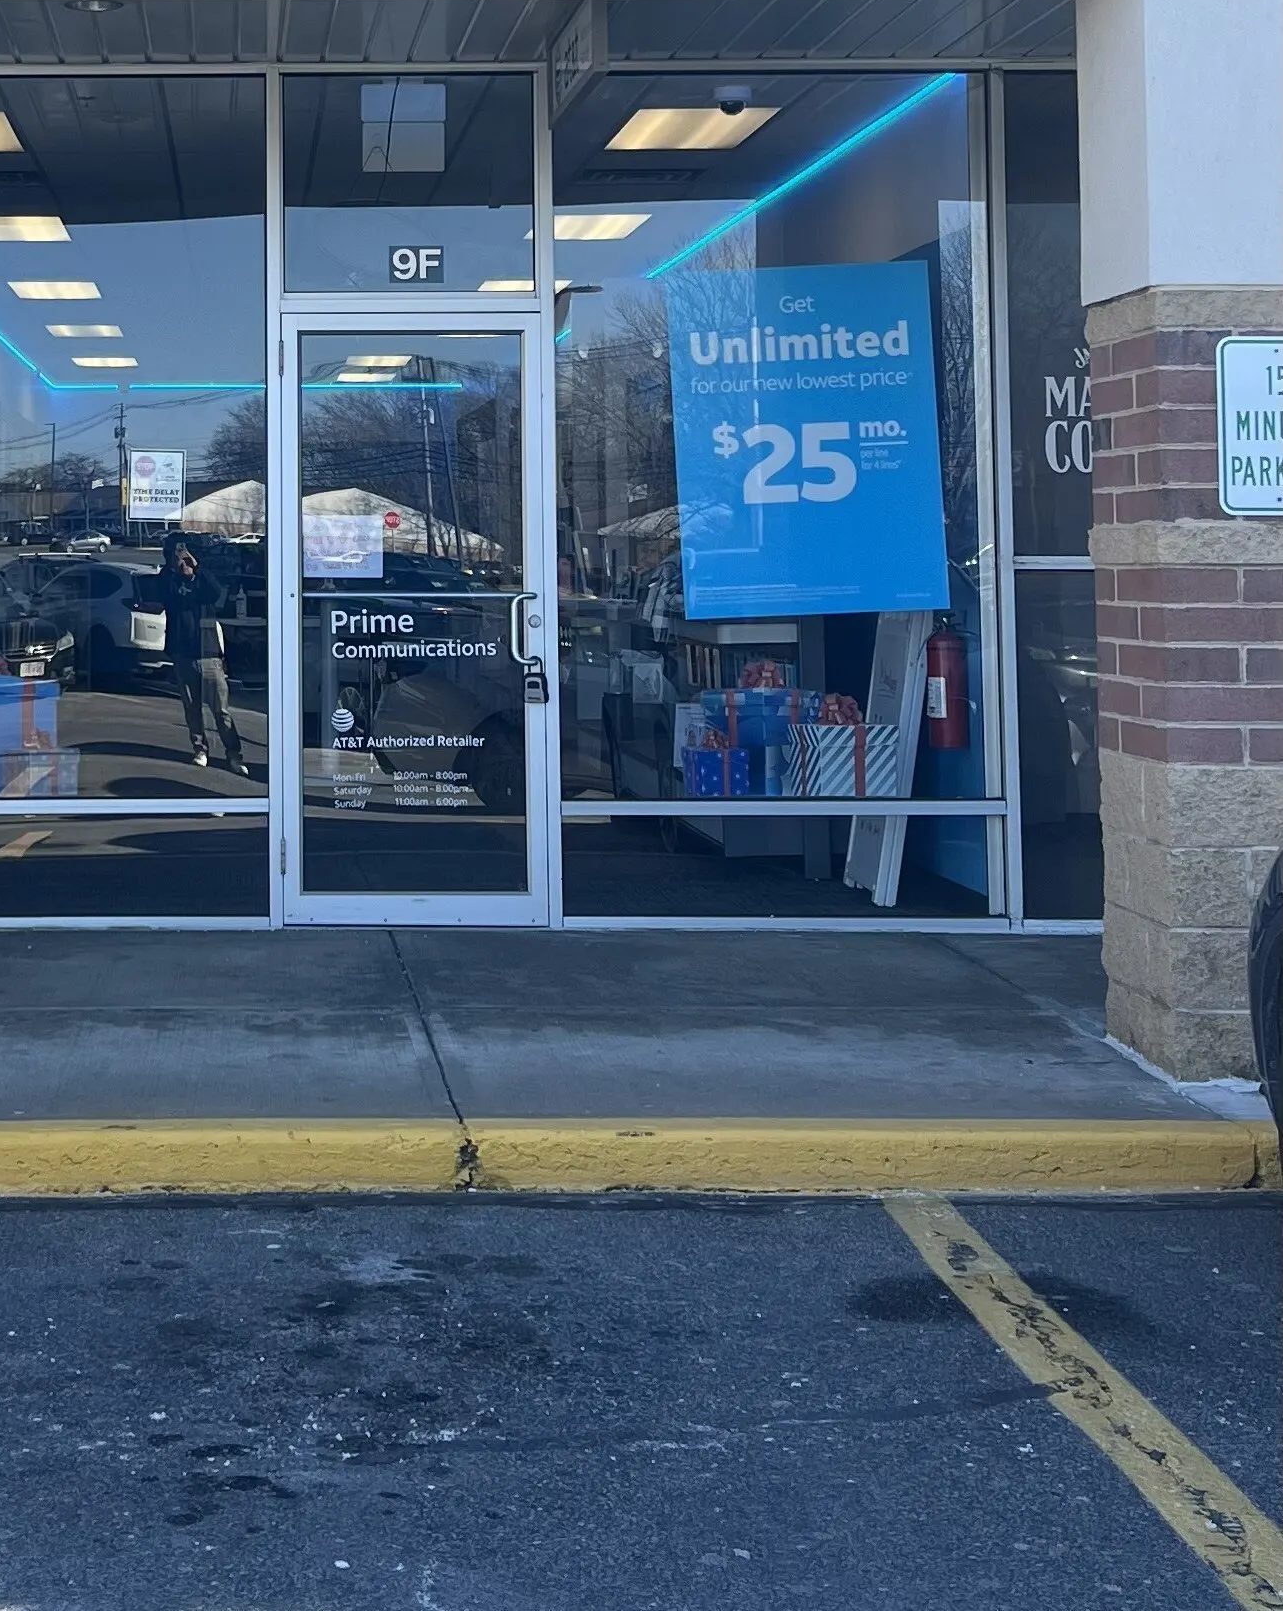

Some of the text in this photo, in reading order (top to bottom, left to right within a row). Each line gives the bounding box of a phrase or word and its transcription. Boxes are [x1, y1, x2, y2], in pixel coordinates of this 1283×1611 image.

[392, 248, 441, 280] 9F
[779, 296, 815, 313] Get
[690, 320, 909, 365] Unlimited
[691, 377, 717, 394] for
[721, 380, 749, 393] our
[756, 376, 793, 391] new
[796, 372, 855, 389] lowest
[859, 420, 907, 438] mo.
[1236, 410, 1283, 441] MIN
[133, 496, 179, 504] PROTECTED
[330, 609, 414, 634] Prime
[332, 639, 497, 659] Communications
[332, 735, 485, 749] AT&T Authorized Retailer
[333, 785, 372, 796] Saturday
[334, 799, 366, 809] Sunday
